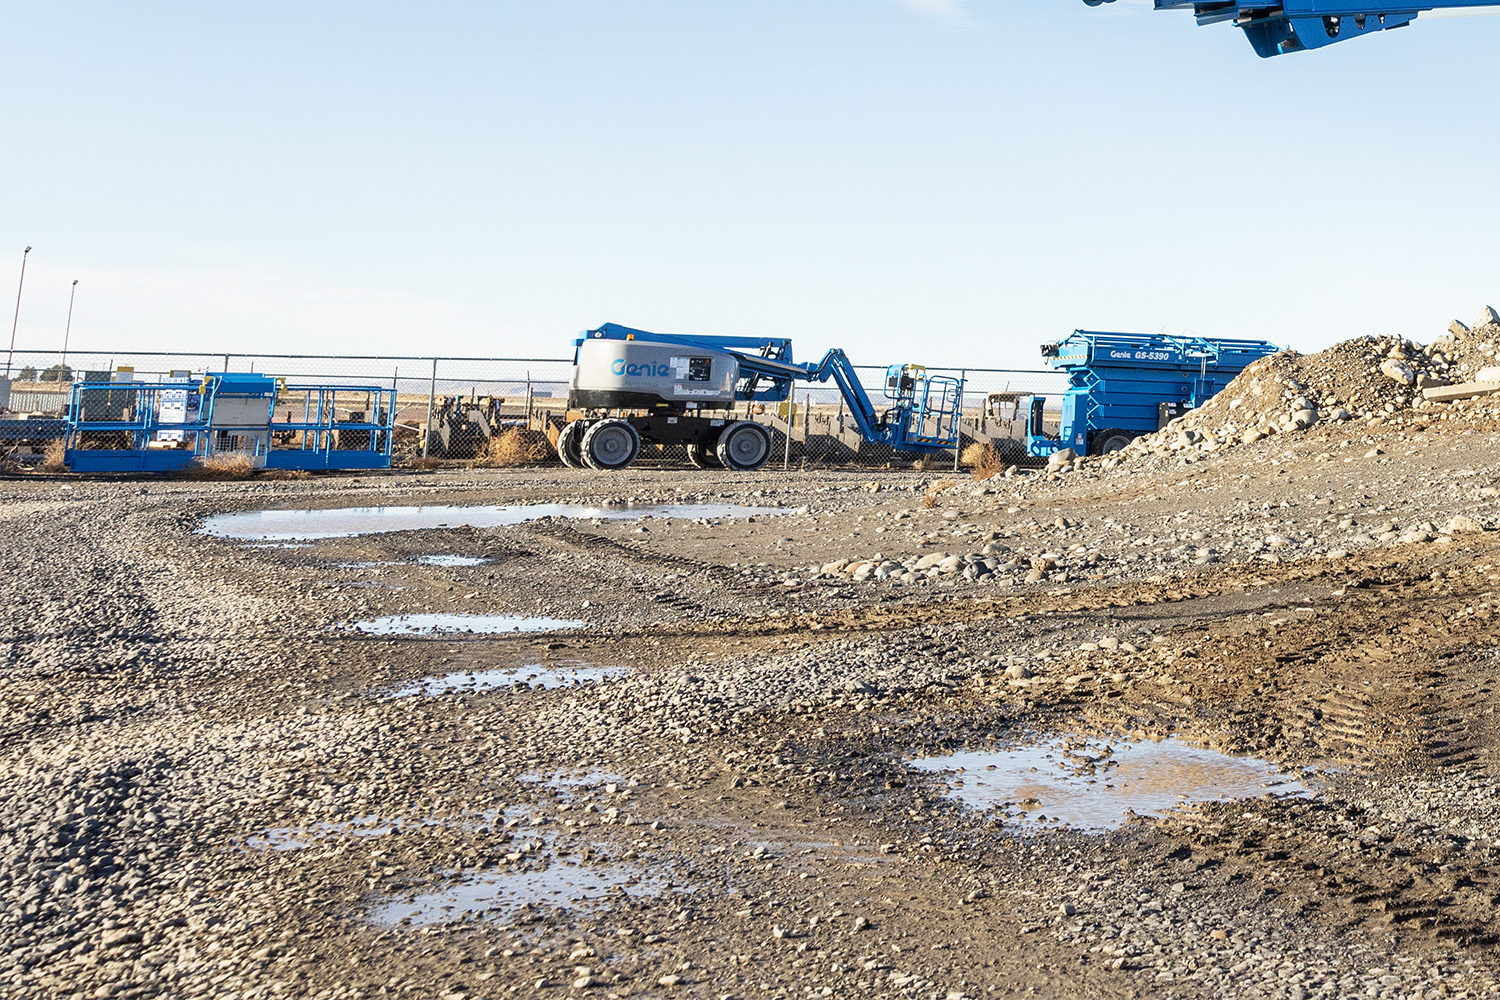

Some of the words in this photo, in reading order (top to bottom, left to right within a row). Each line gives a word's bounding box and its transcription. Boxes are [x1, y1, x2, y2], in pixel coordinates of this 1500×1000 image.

[1110, 350, 1132, 359] Genie
[1134, 351, 1170, 361] GS-5390
[611, 358, 670, 377] Genie
